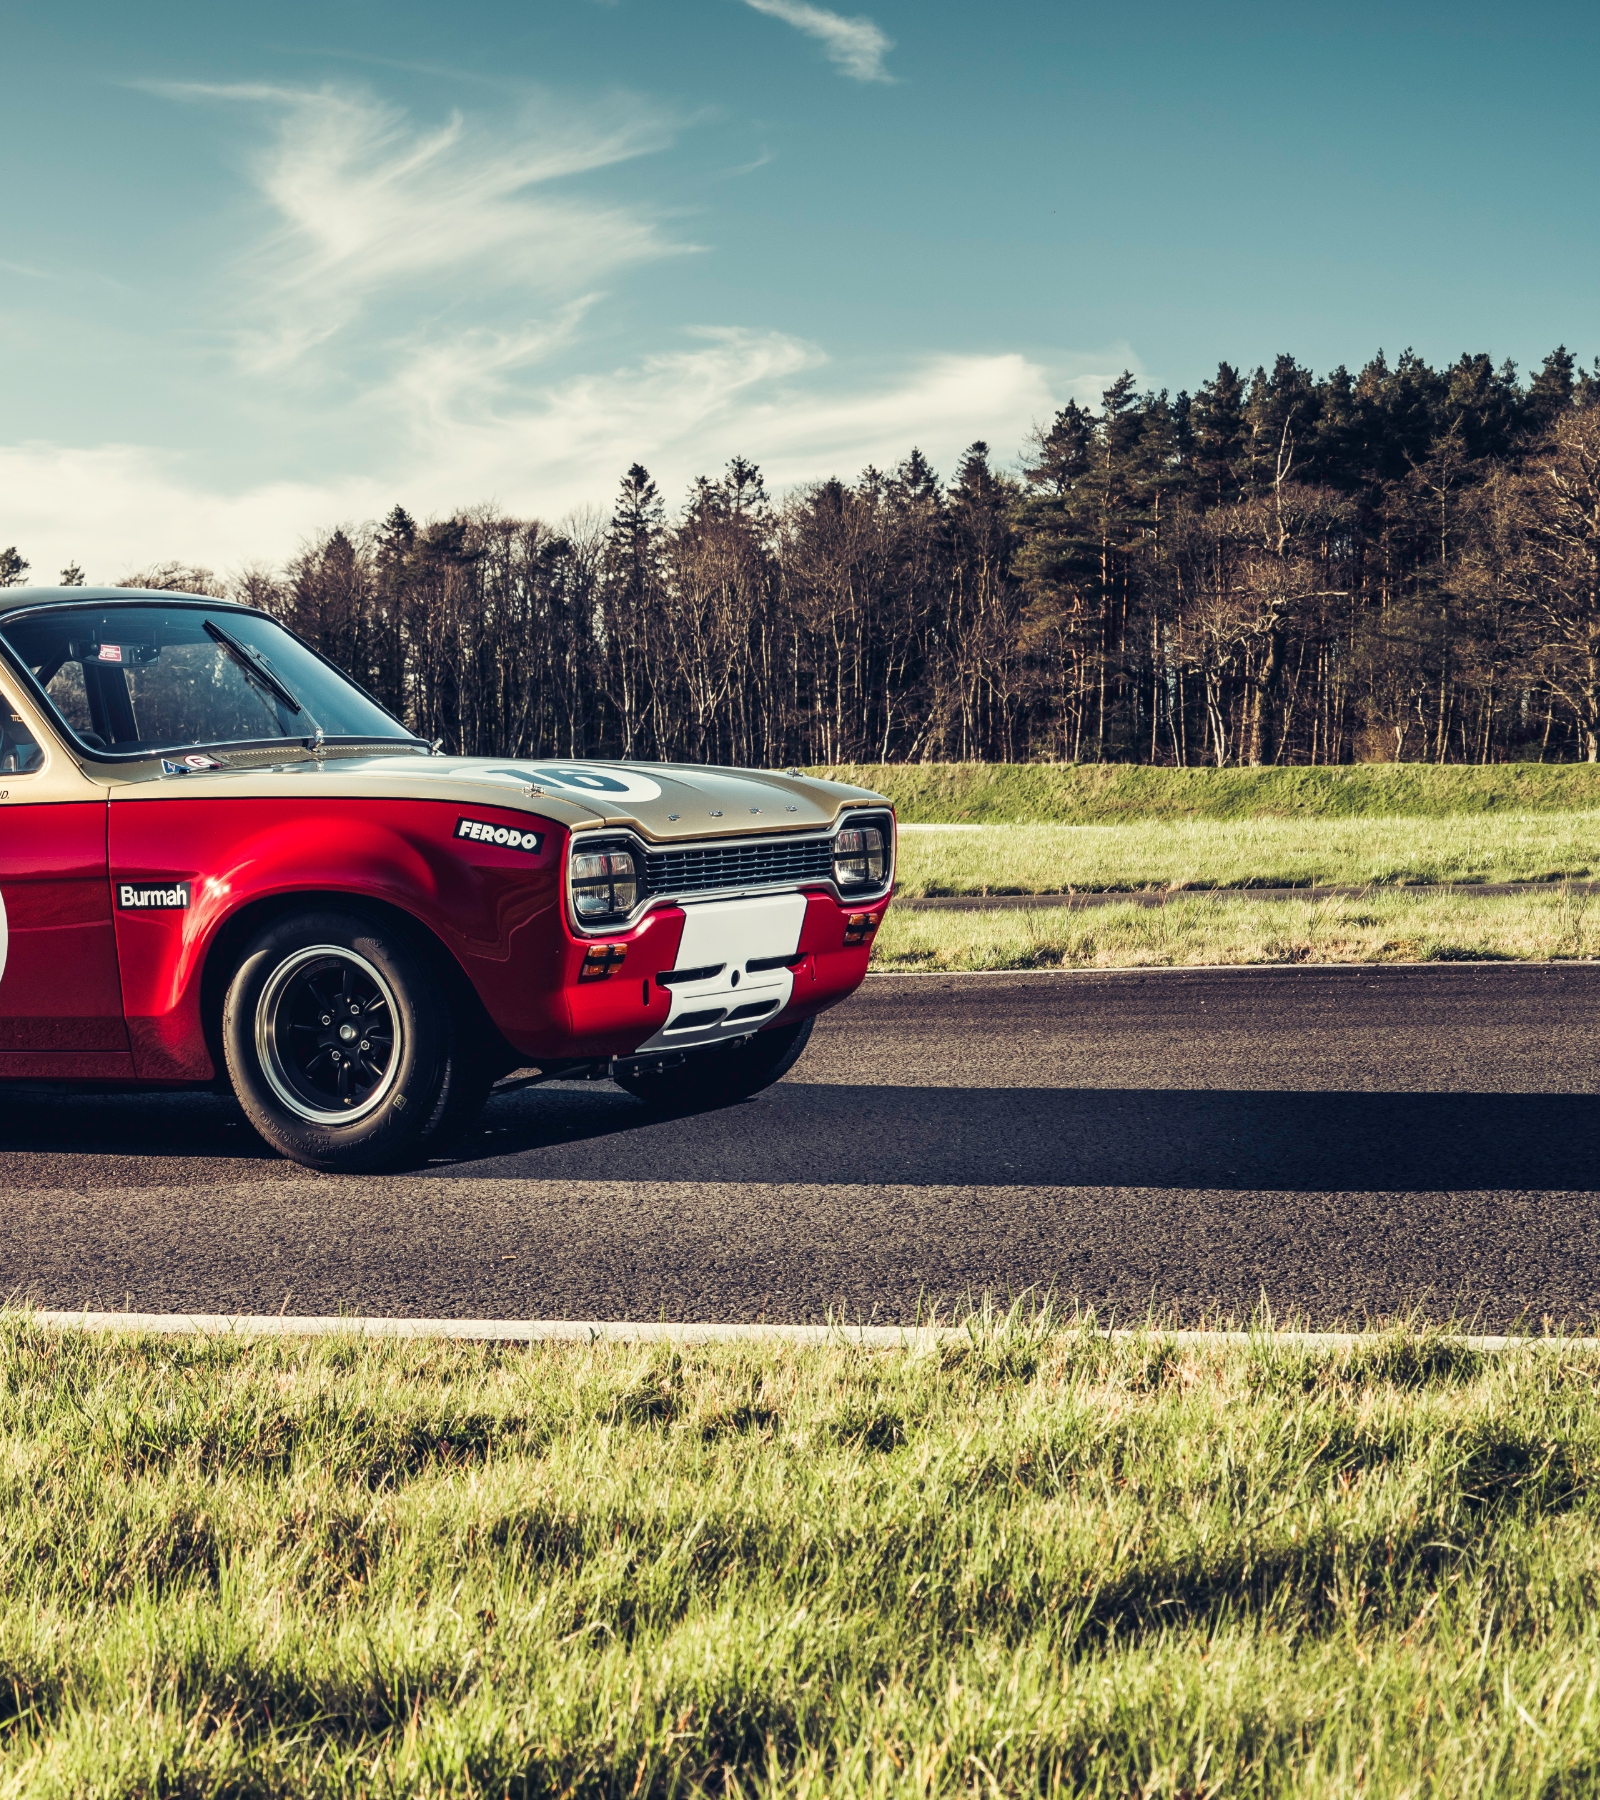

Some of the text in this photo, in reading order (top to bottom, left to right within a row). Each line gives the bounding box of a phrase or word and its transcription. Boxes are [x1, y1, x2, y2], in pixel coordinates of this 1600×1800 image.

[484, 768, 630, 792] 16
[458, 820, 537, 850] FERODO
[120, 884, 187, 906] Burmah
